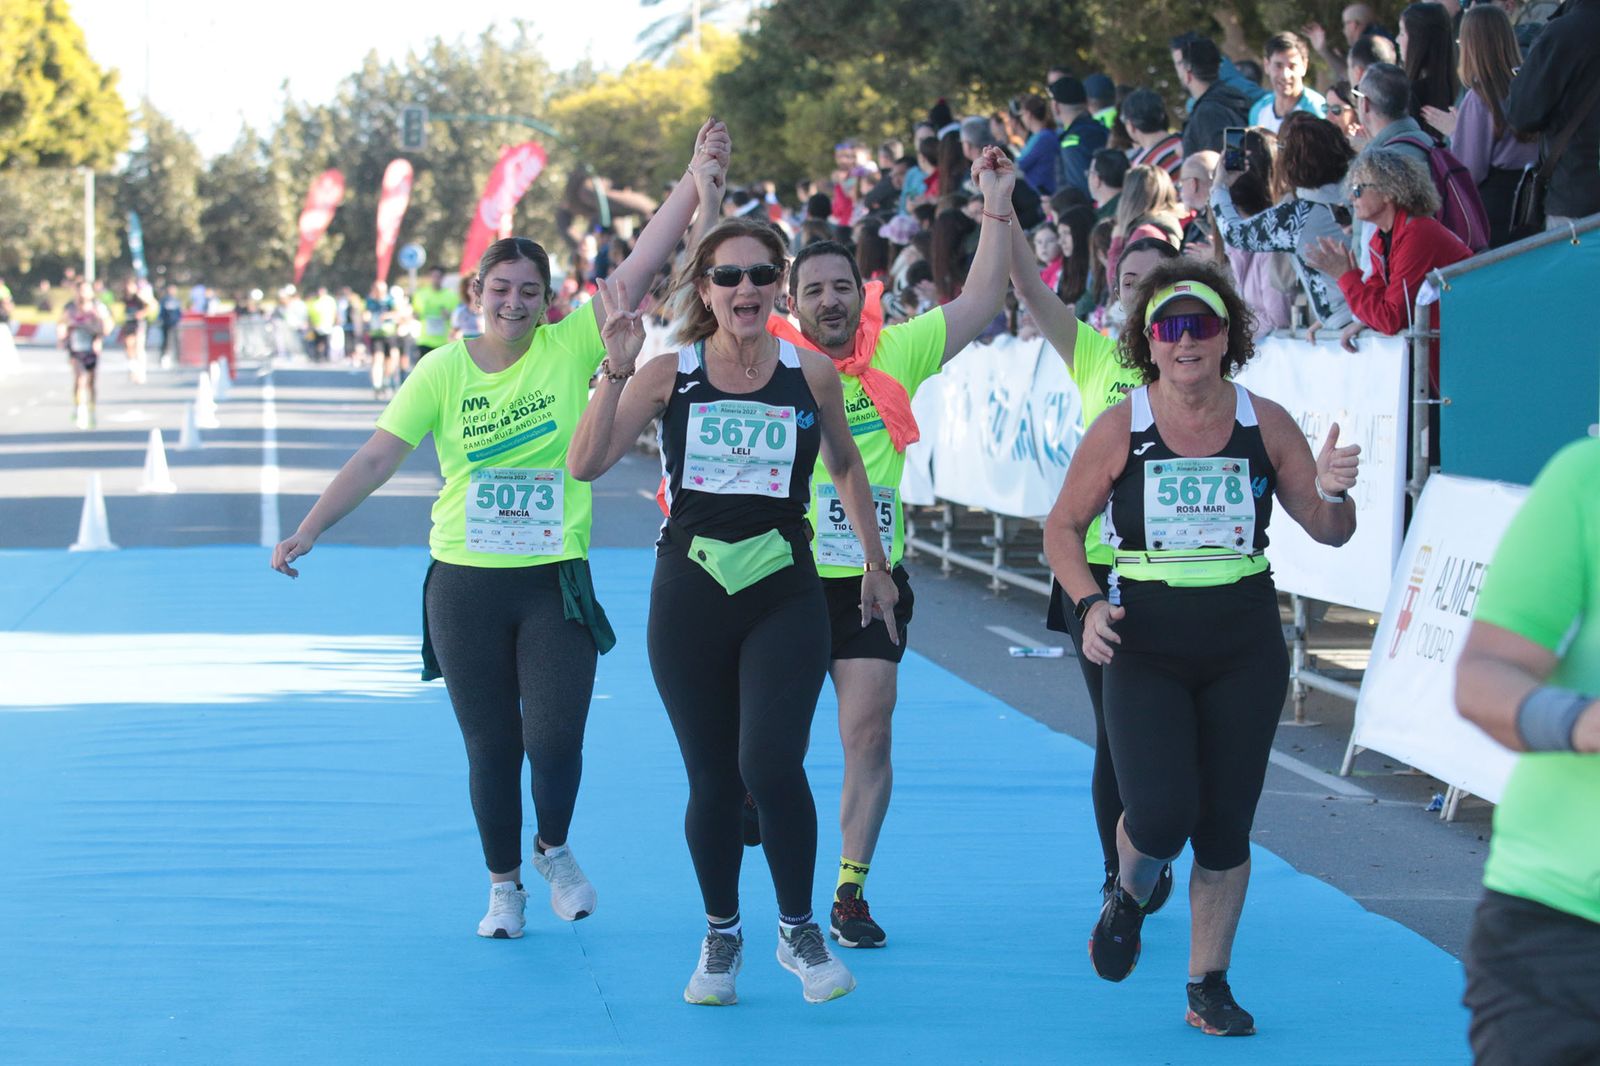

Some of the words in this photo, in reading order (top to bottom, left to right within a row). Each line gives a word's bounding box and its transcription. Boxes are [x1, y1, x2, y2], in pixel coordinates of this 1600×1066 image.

[494, 428, 514, 441] RUIZ
[699, 417, 787, 450] 5670
[731, 447, 751, 455] LELI
[476, 483, 555, 511] 5073
[1157, 475, 1244, 506] 5678
[828, 498, 892, 527] 55
[1176, 505, 1200, 513] ROSA
[1203, 505, 1226, 513] MARI
[1416, 622, 1455, 663] CIUDAD
